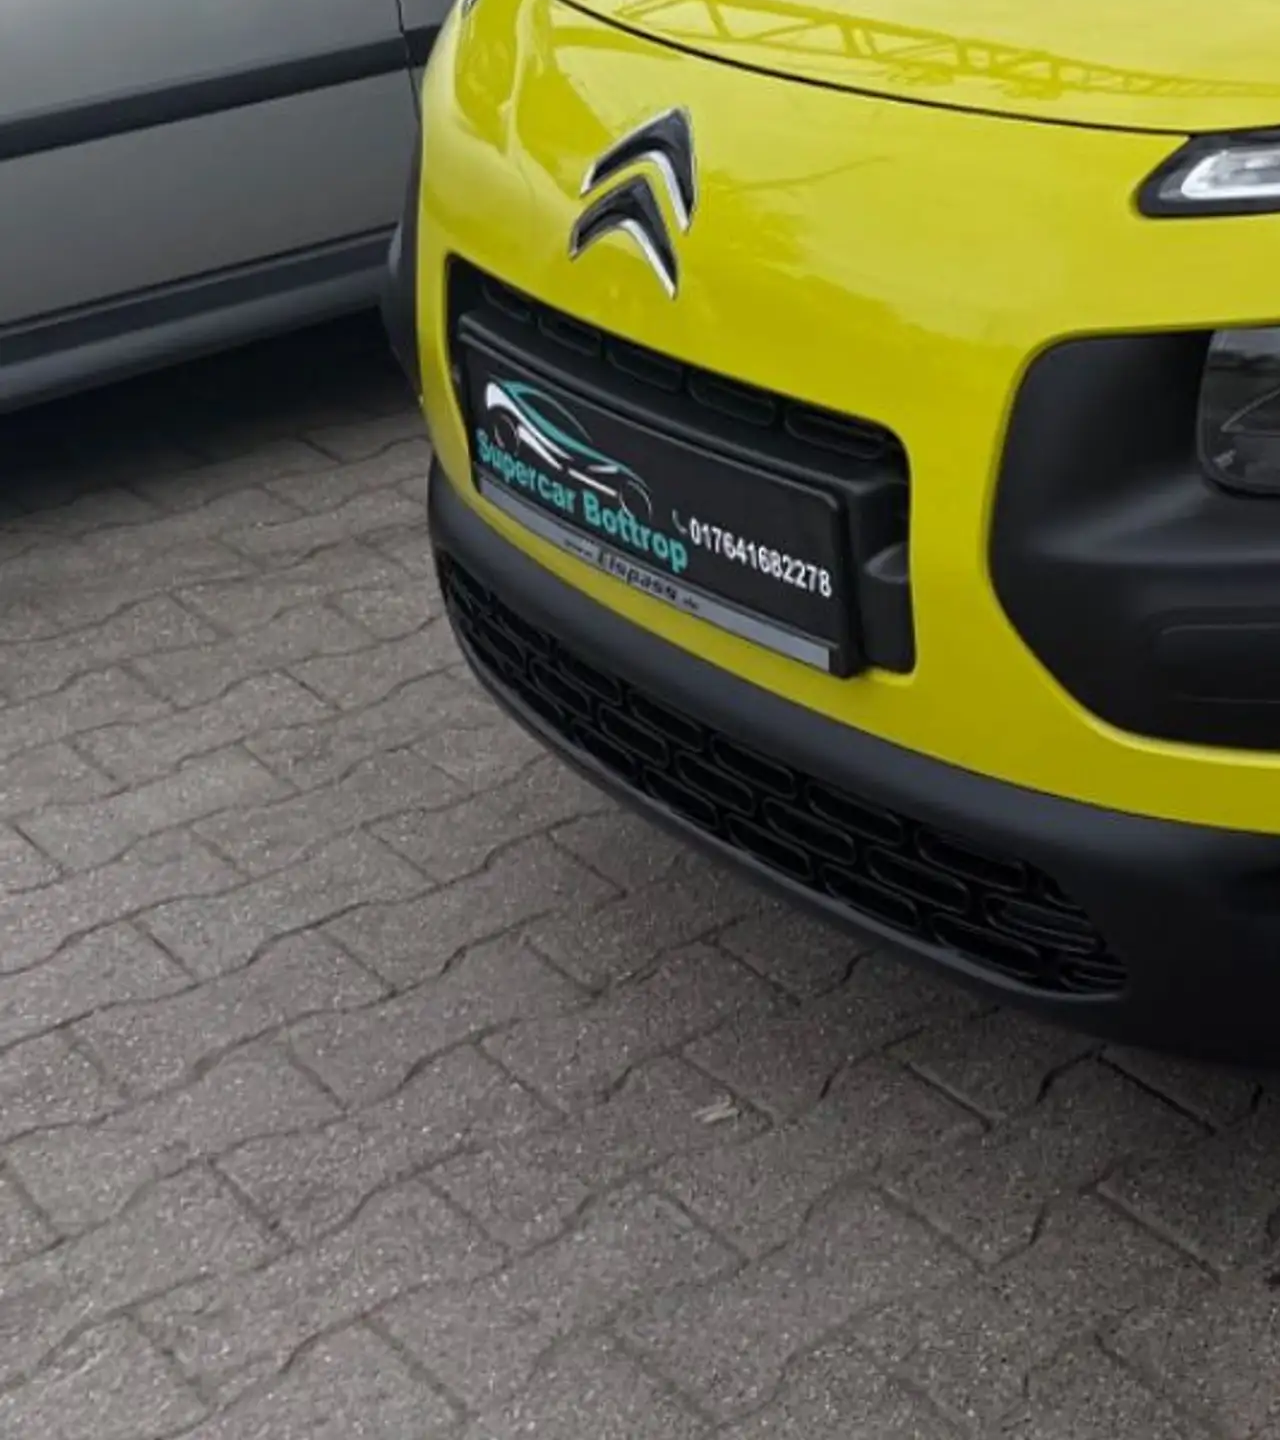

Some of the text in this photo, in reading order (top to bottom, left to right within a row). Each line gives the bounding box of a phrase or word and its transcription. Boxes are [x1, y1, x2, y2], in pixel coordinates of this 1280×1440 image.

[476, 427, 689, 574] Supercar Bottrop
[689, 517, 833, 599] 017641682278
